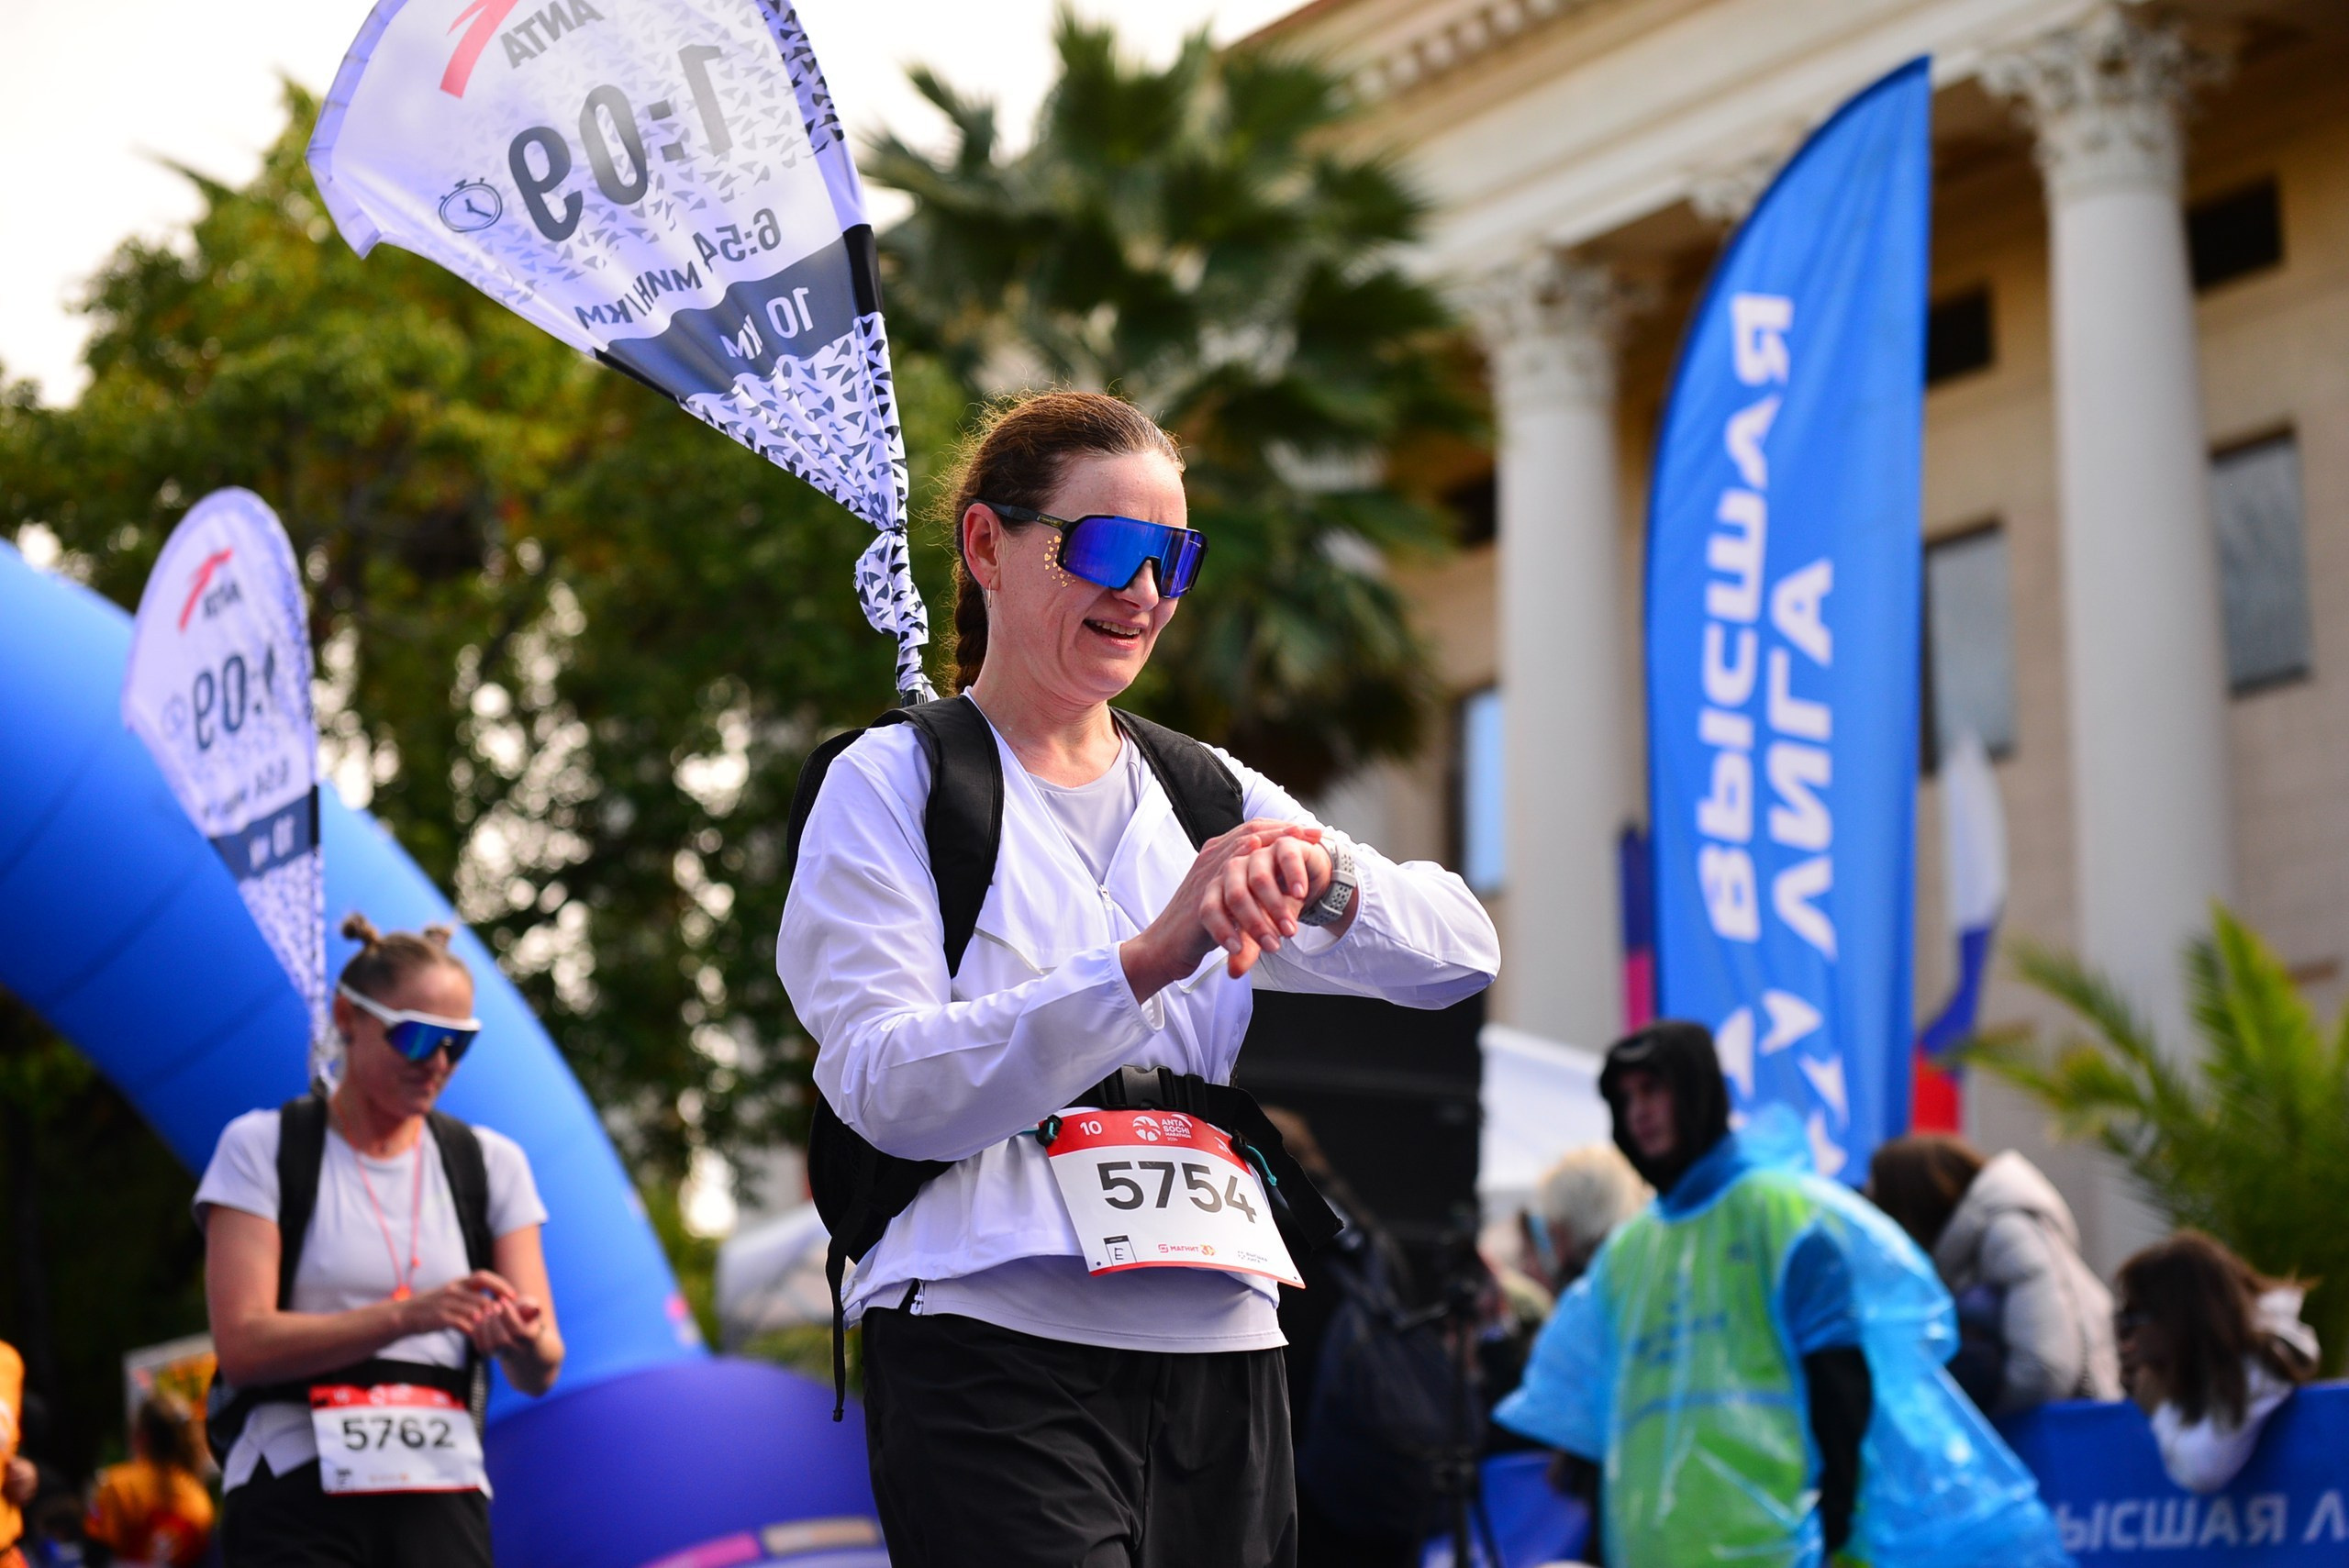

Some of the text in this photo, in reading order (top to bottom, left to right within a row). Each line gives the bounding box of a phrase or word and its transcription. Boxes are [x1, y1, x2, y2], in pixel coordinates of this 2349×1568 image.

[1079, 1119, 1103, 1137] 10
[1161, 1118, 1185, 1128] ANTA
[1163, 1125, 1191, 1135] SOCHI
[1097, 1161, 1257, 1224] 5754
[342, 1416, 455, 1451] 5762
[2056, 1494, 2288, 1551] ЫСШАЯ
